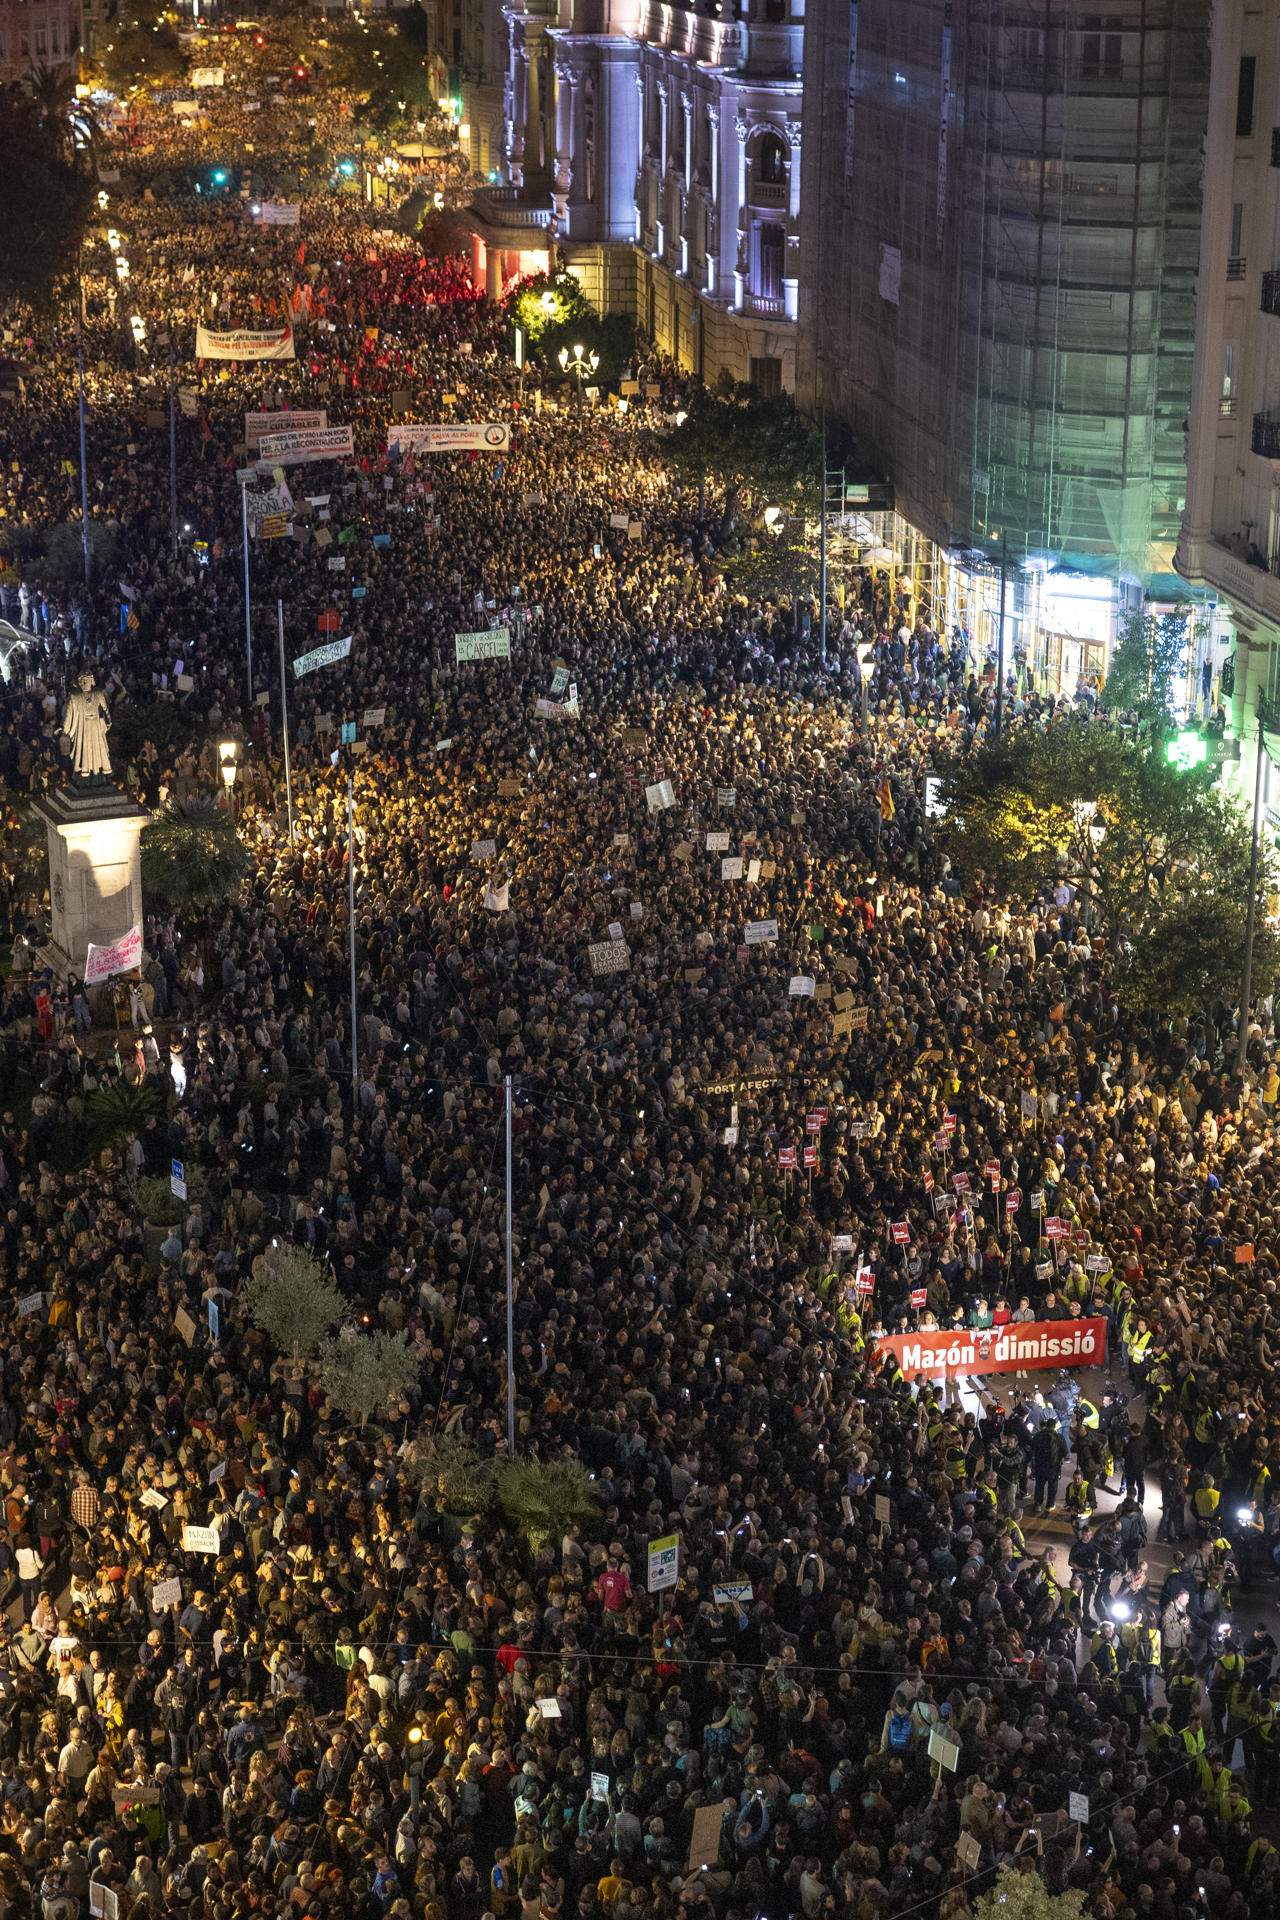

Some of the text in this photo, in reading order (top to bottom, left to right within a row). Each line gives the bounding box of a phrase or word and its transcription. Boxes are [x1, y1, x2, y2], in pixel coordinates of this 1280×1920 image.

[270, 421, 320, 430] CULPABLES!
[613, 939, 625, 947] QUE
[590, 947, 627, 961] TODOS
[903, 1329, 1095, 1370] Mazón dimissió
